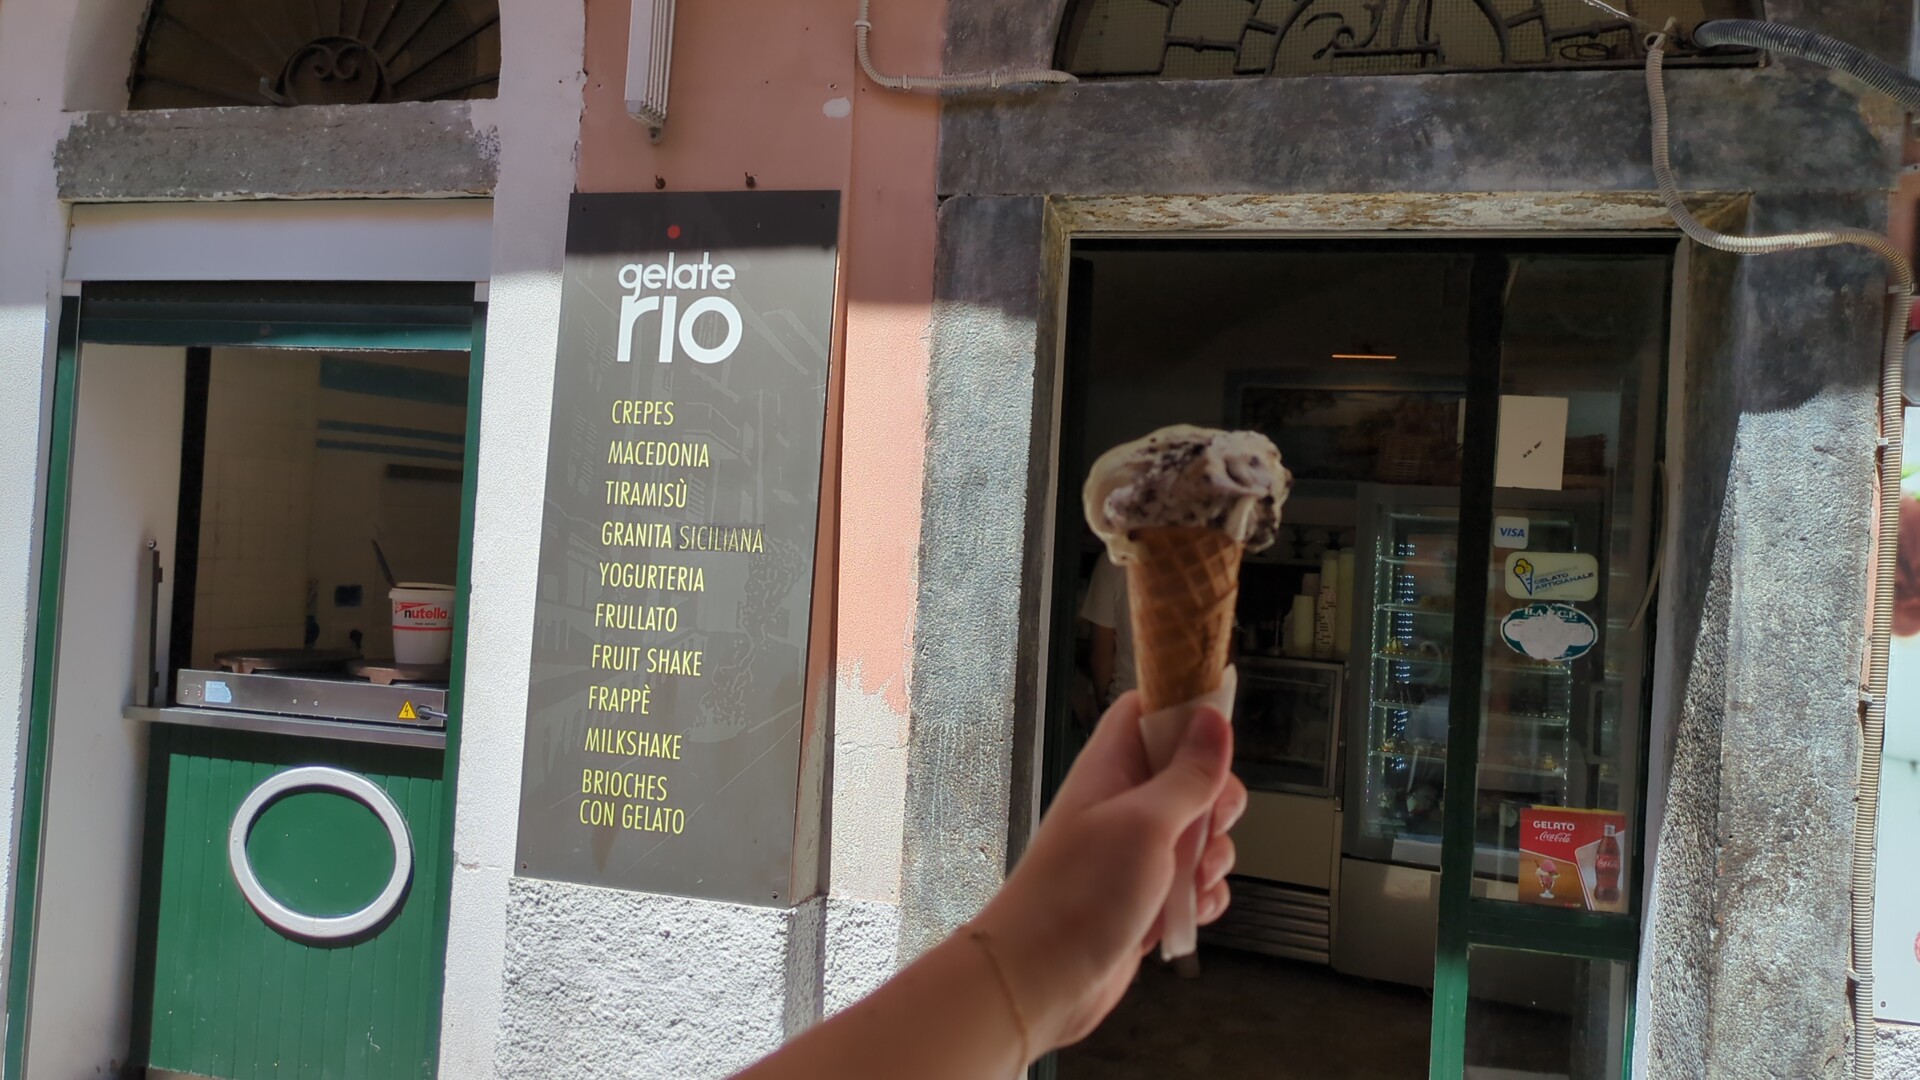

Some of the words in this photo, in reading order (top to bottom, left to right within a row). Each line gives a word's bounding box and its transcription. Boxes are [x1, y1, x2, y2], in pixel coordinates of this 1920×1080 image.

[618, 251, 736, 300] gelate
[617, 296, 743, 364] rio
[612, 400, 674, 425] CREPES
[608, 440, 710, 467] MACEDONIA
[606, 478, 687, 508] TIRAMISÙ
[602, 521, 672, 549] GRANITA
[679, 525, 764, 553] SICILIANA
[1500, 527, 1525, 538] VISA
[600, 562, 704, 592] YOGURTERIA
[404, 607, 447, 619] nutella
[595, 603, 678, 632] FRULLATO
[592, 644, 640, 672] FRUIT
[647, 648, 702, 676] SHAKE
[588, 684, 651, 714] FRAPPÈ
[585, 728, 682, 760] MILKSHAKE
[582, 768, 668, 801] BRIOCHES
[580, 800, 615, 828] CON
[622, 804, 685, 835] GELATO
[1533, 820, 1575, 831] GELATO
